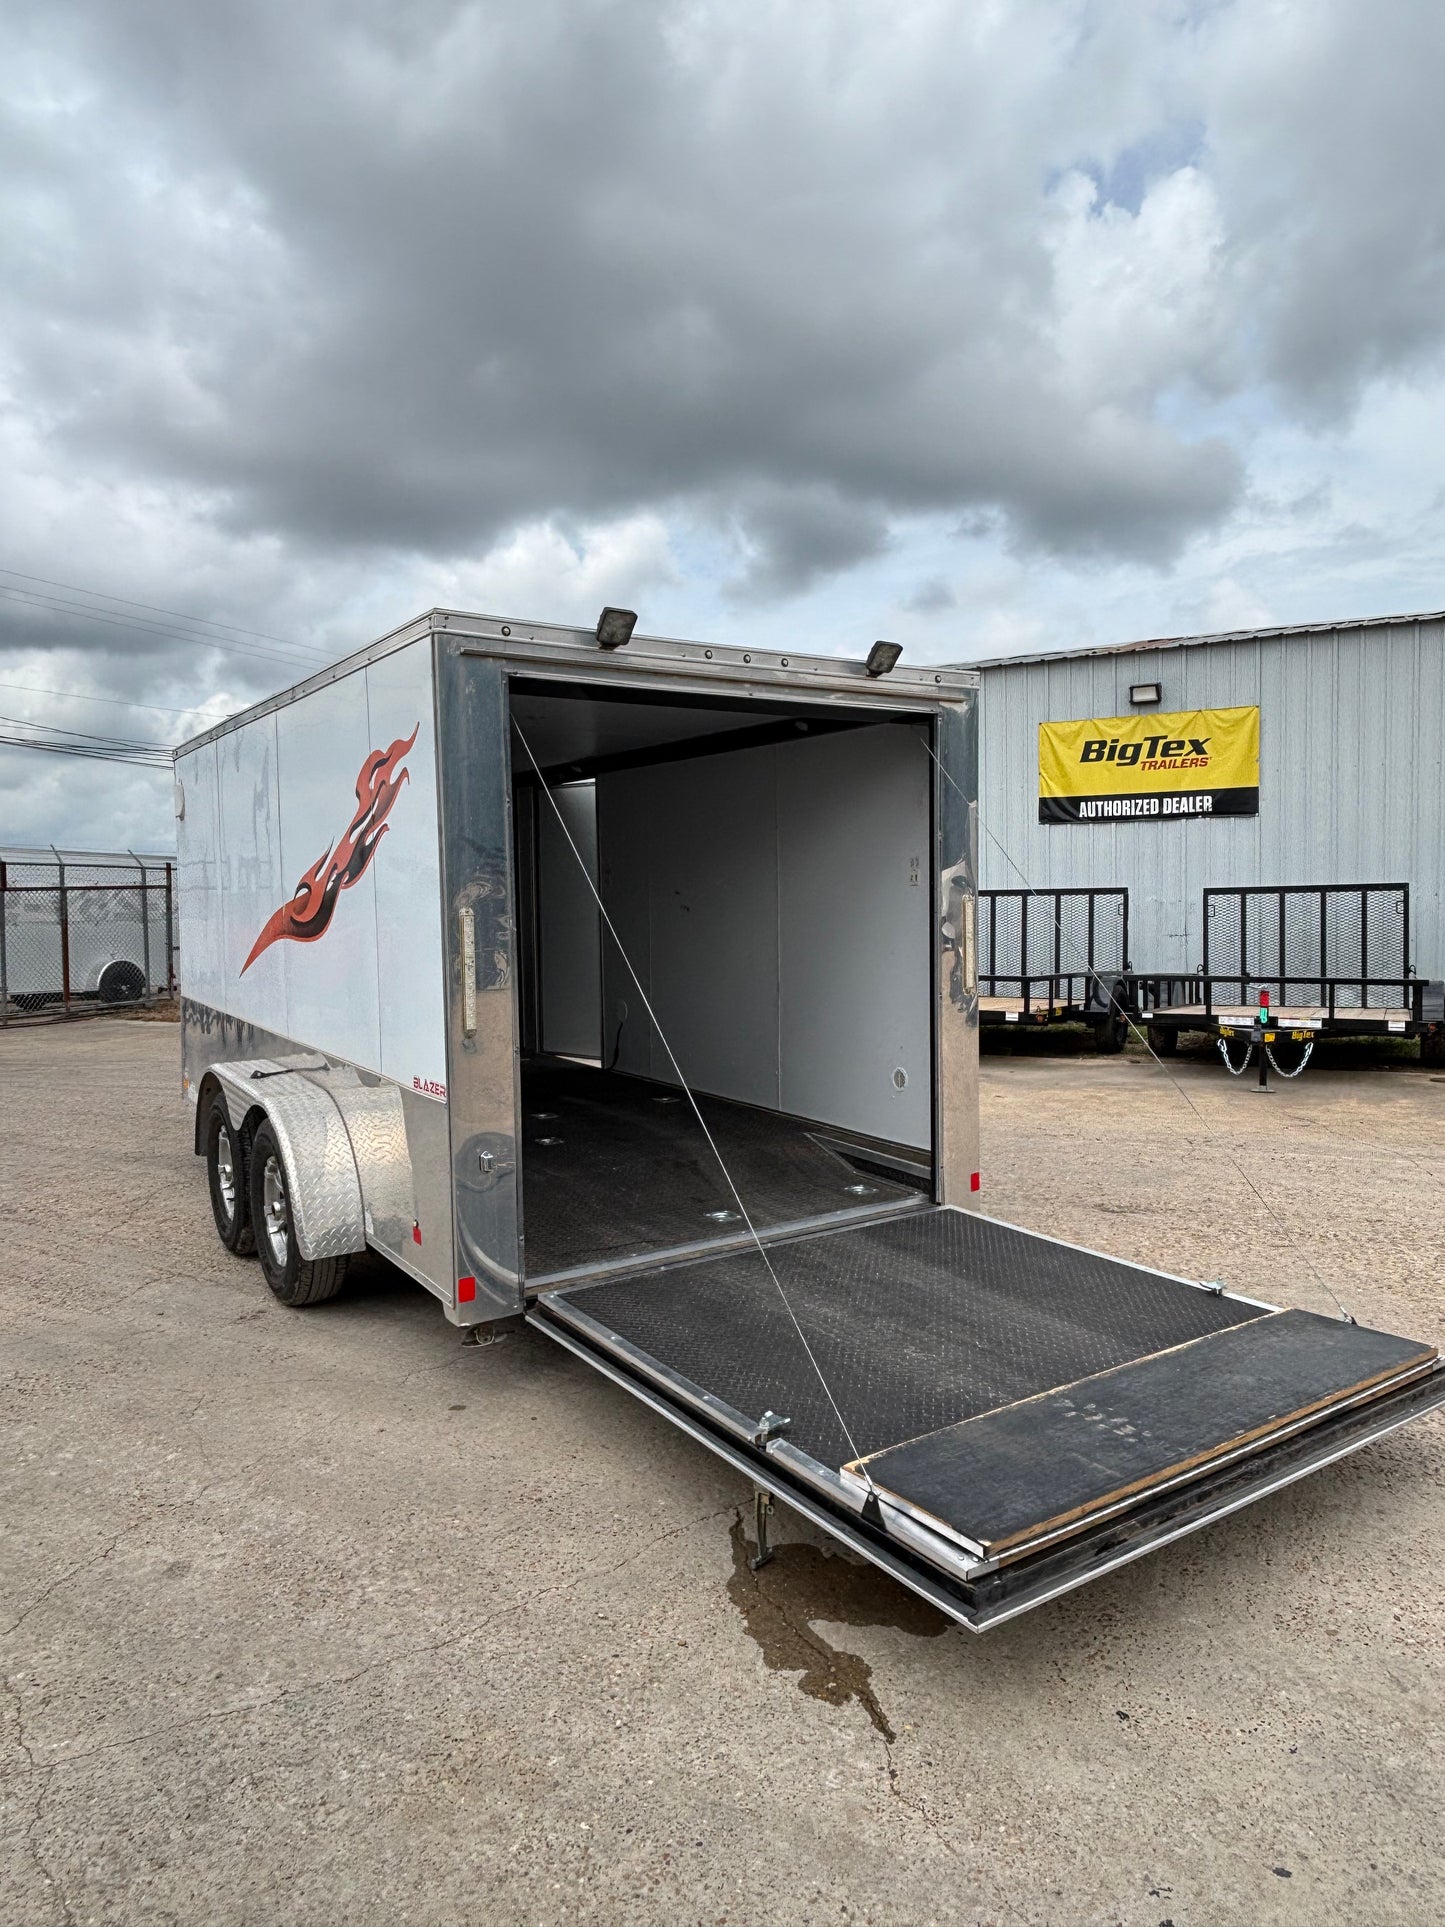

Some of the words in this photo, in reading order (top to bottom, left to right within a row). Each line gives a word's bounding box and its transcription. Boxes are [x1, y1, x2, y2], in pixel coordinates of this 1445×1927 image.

[1140, 757, 1210, 771] TRAILERS
[1079, 798, 1159, 818] AUTHORIZED
[1162, 795, 1213, 814] DEALER
[413, 1076, 446, 1097] BLAZER
